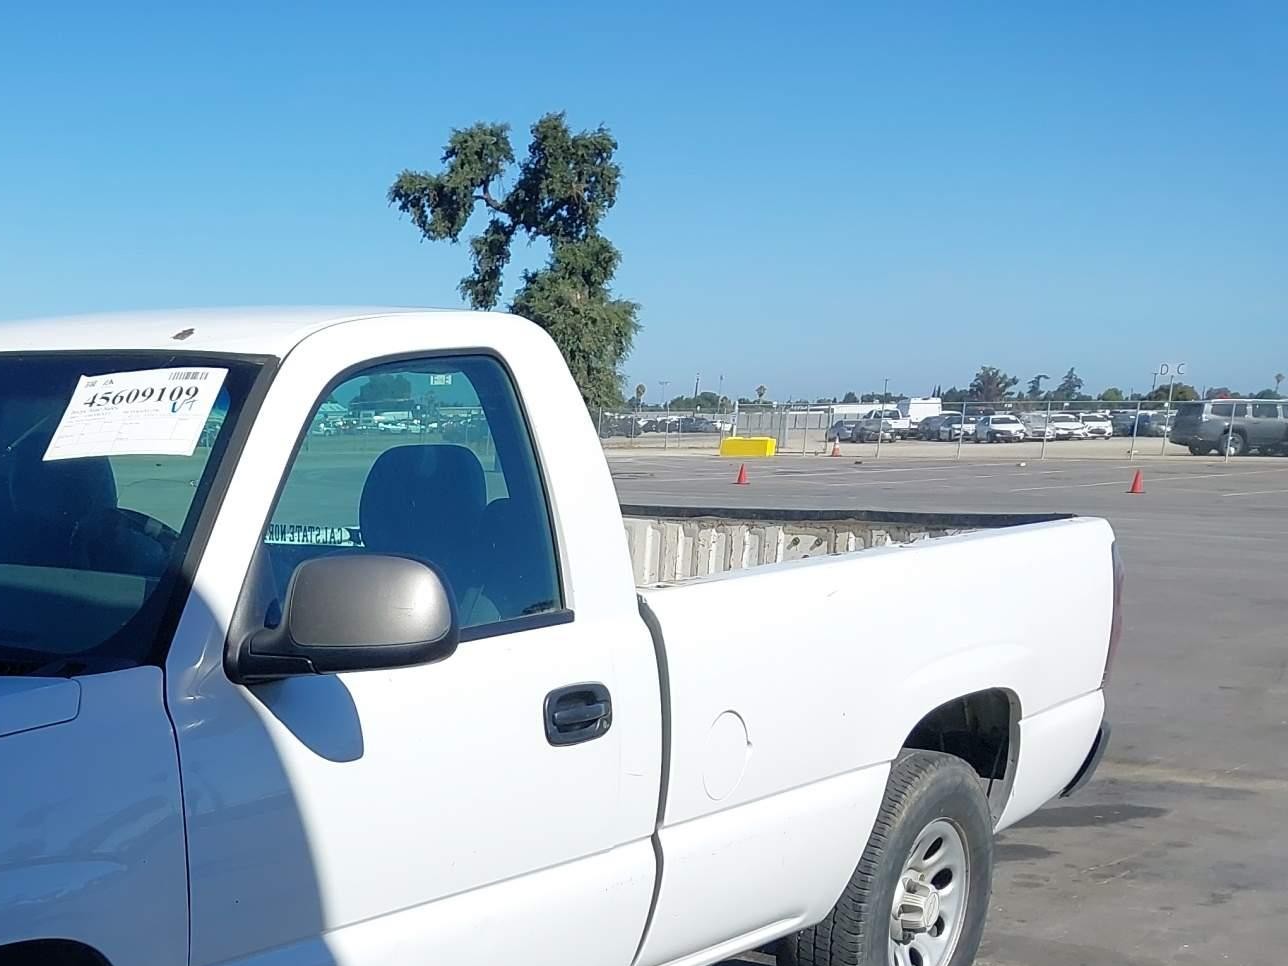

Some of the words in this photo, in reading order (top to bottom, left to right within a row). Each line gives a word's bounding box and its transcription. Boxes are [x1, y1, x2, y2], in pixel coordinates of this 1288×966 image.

[1160, 363, 1168, 375] D
[1177, 363, 1185, 375] C
[83, 386, 199, 407] 45609109
